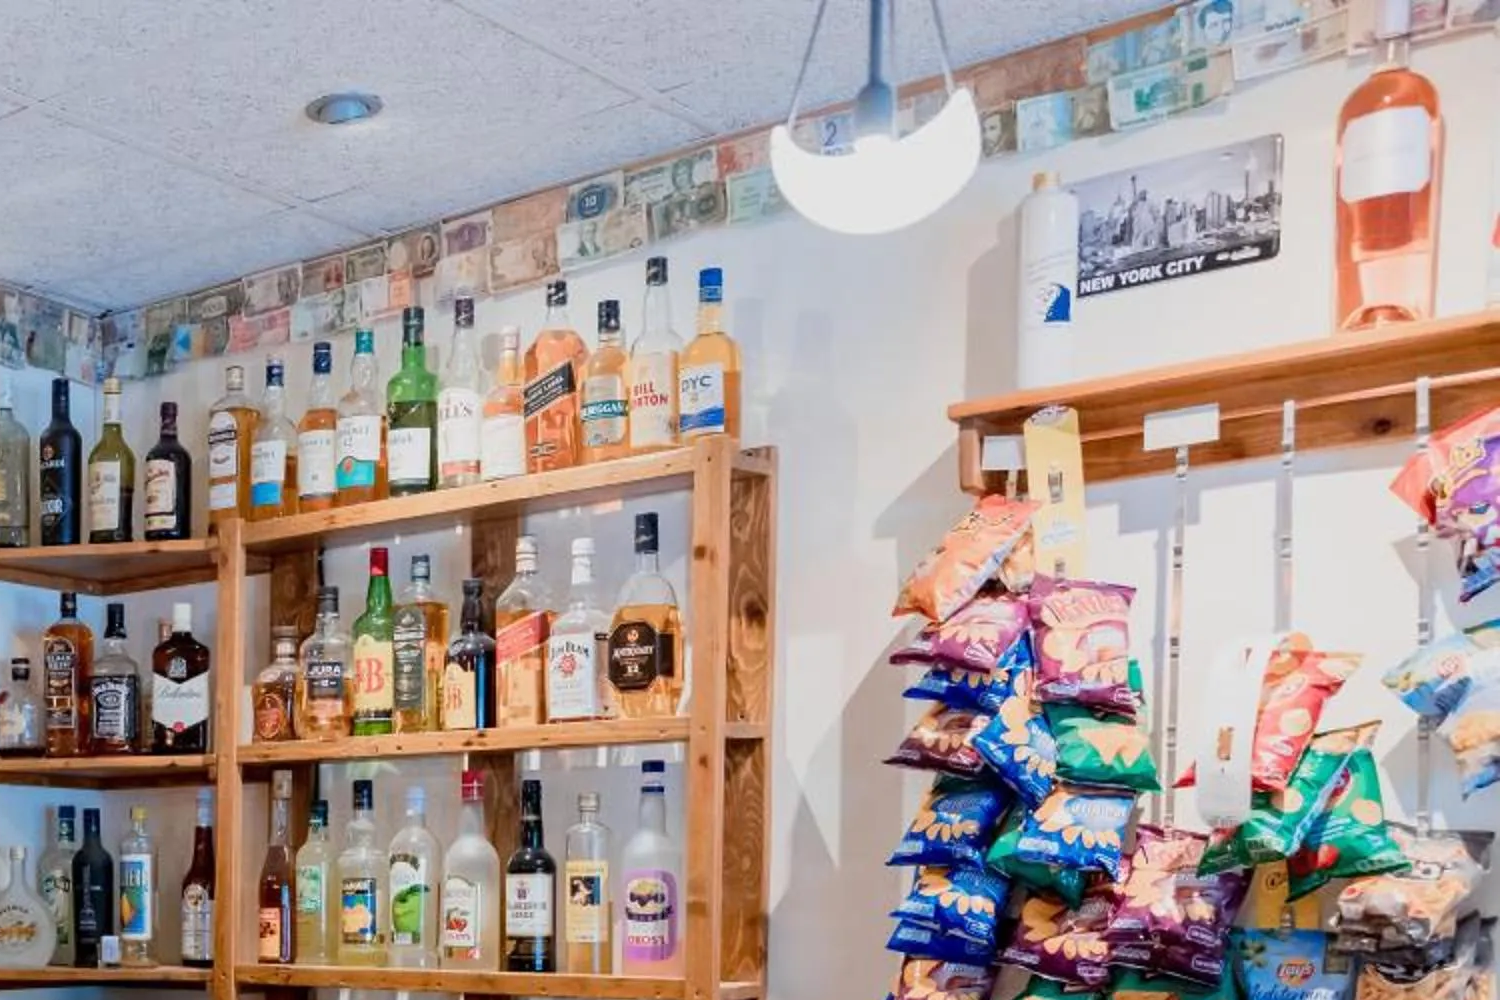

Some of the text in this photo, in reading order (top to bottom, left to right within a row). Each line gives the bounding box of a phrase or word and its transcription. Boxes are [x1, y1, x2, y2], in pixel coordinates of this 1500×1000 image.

[1079, 275, 1115, 294] NEW
[1118, 265, 1164, 286] YORK
[1165, 256, 1205, 275] CITY
